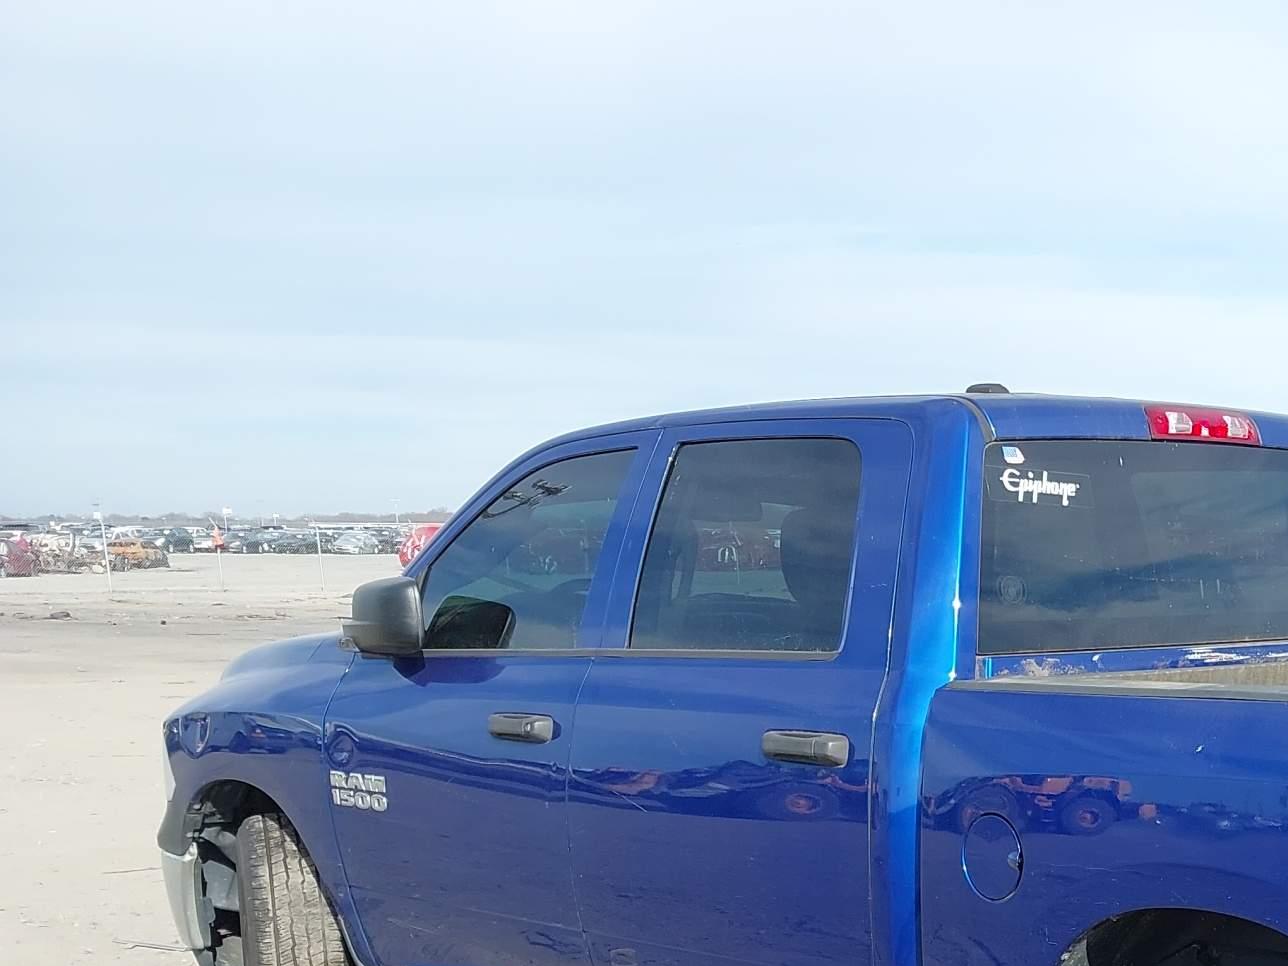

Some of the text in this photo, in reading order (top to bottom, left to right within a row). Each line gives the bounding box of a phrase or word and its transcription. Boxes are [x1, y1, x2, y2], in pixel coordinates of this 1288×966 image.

[1000, 468, 1080, 506] Epiphone
[329, 770, 386, 793] RAM
[331, 788, 388, 812] 1500
